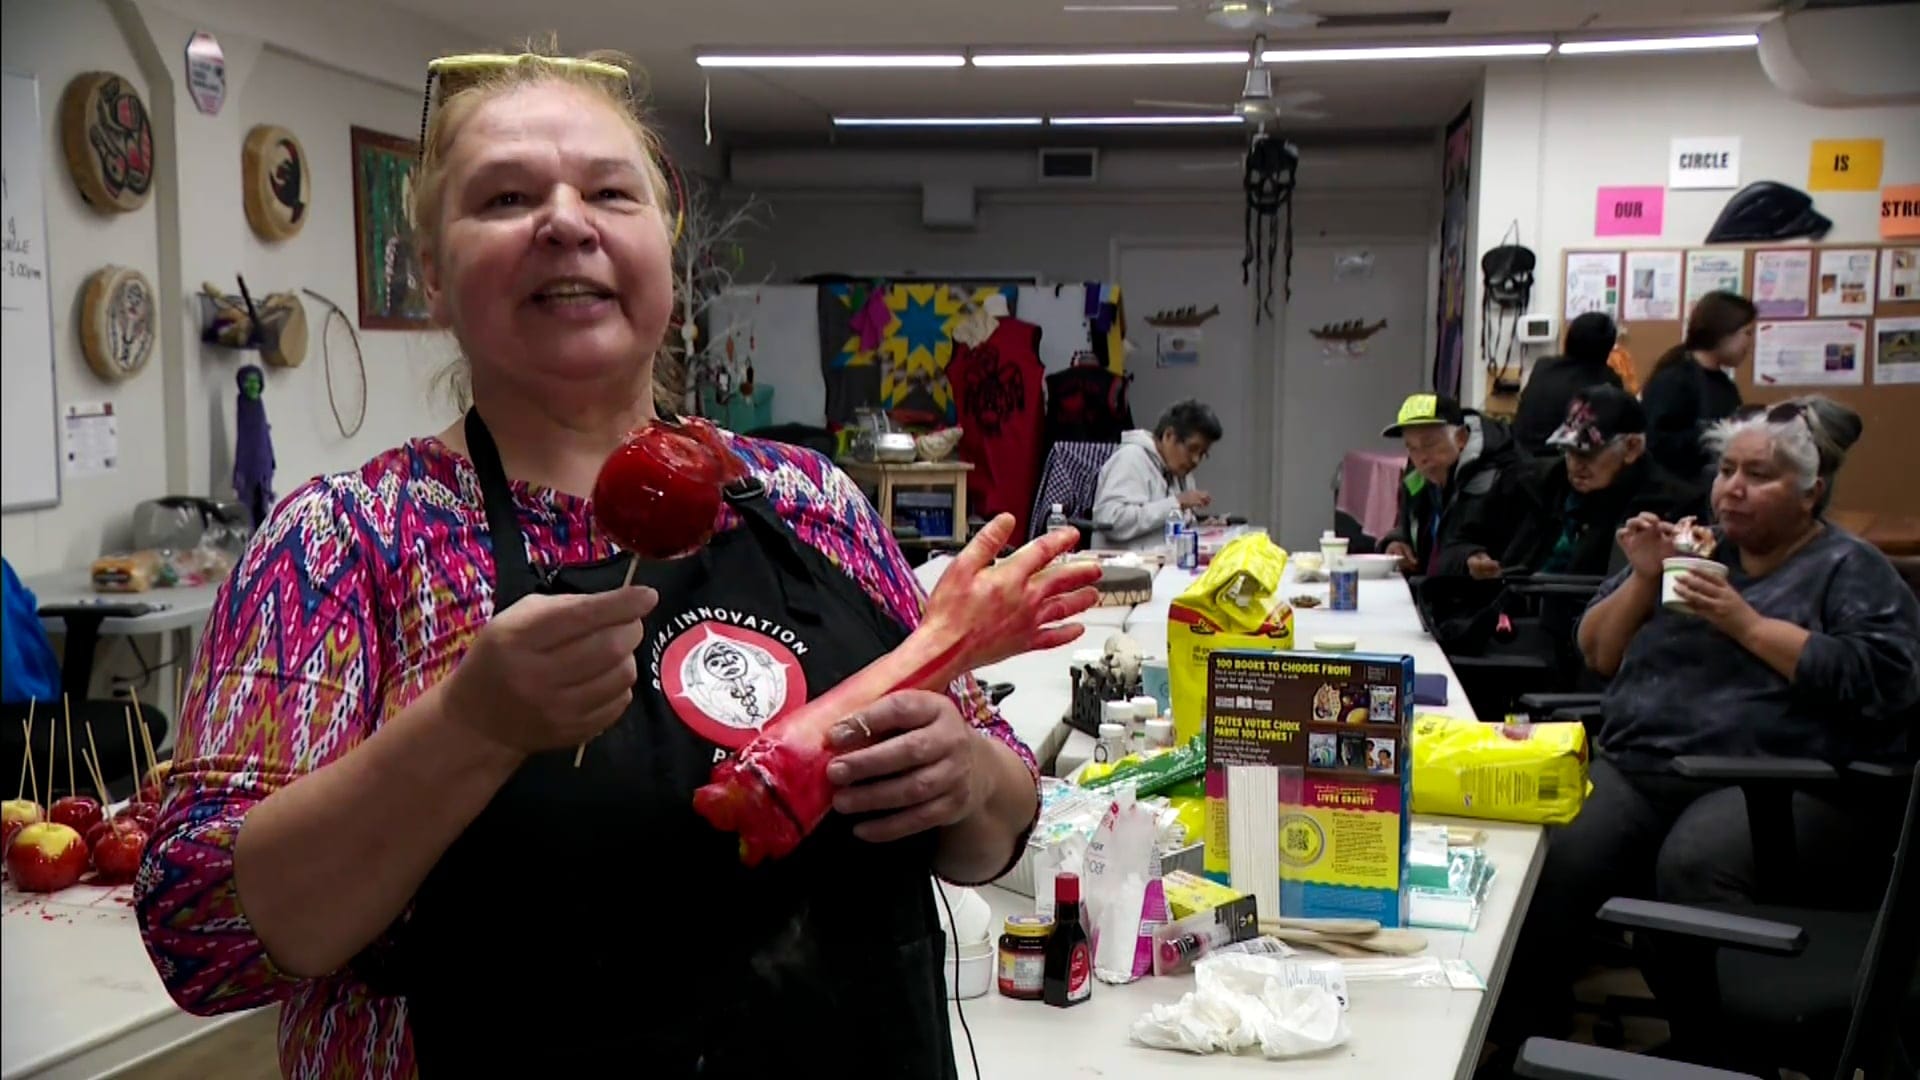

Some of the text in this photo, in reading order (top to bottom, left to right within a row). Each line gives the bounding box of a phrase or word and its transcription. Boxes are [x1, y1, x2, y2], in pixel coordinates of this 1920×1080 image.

[1679, 152, 1729, 169] CIRCLE
[1834, 154, 1850, 171] IS
[1614, 201, 1643, 218] OUR
[674, 606, 808, 656] INNOVATION
[1216, 658, 1351, 676] 100 BOOKS TO CHOOSE FROM!
[1214, 716, 1301, 731] FAITES VOTRE CHOIX
[1241, 729, 1256, 739] 100
[1258, 730, 1287, 741] LIVRES
